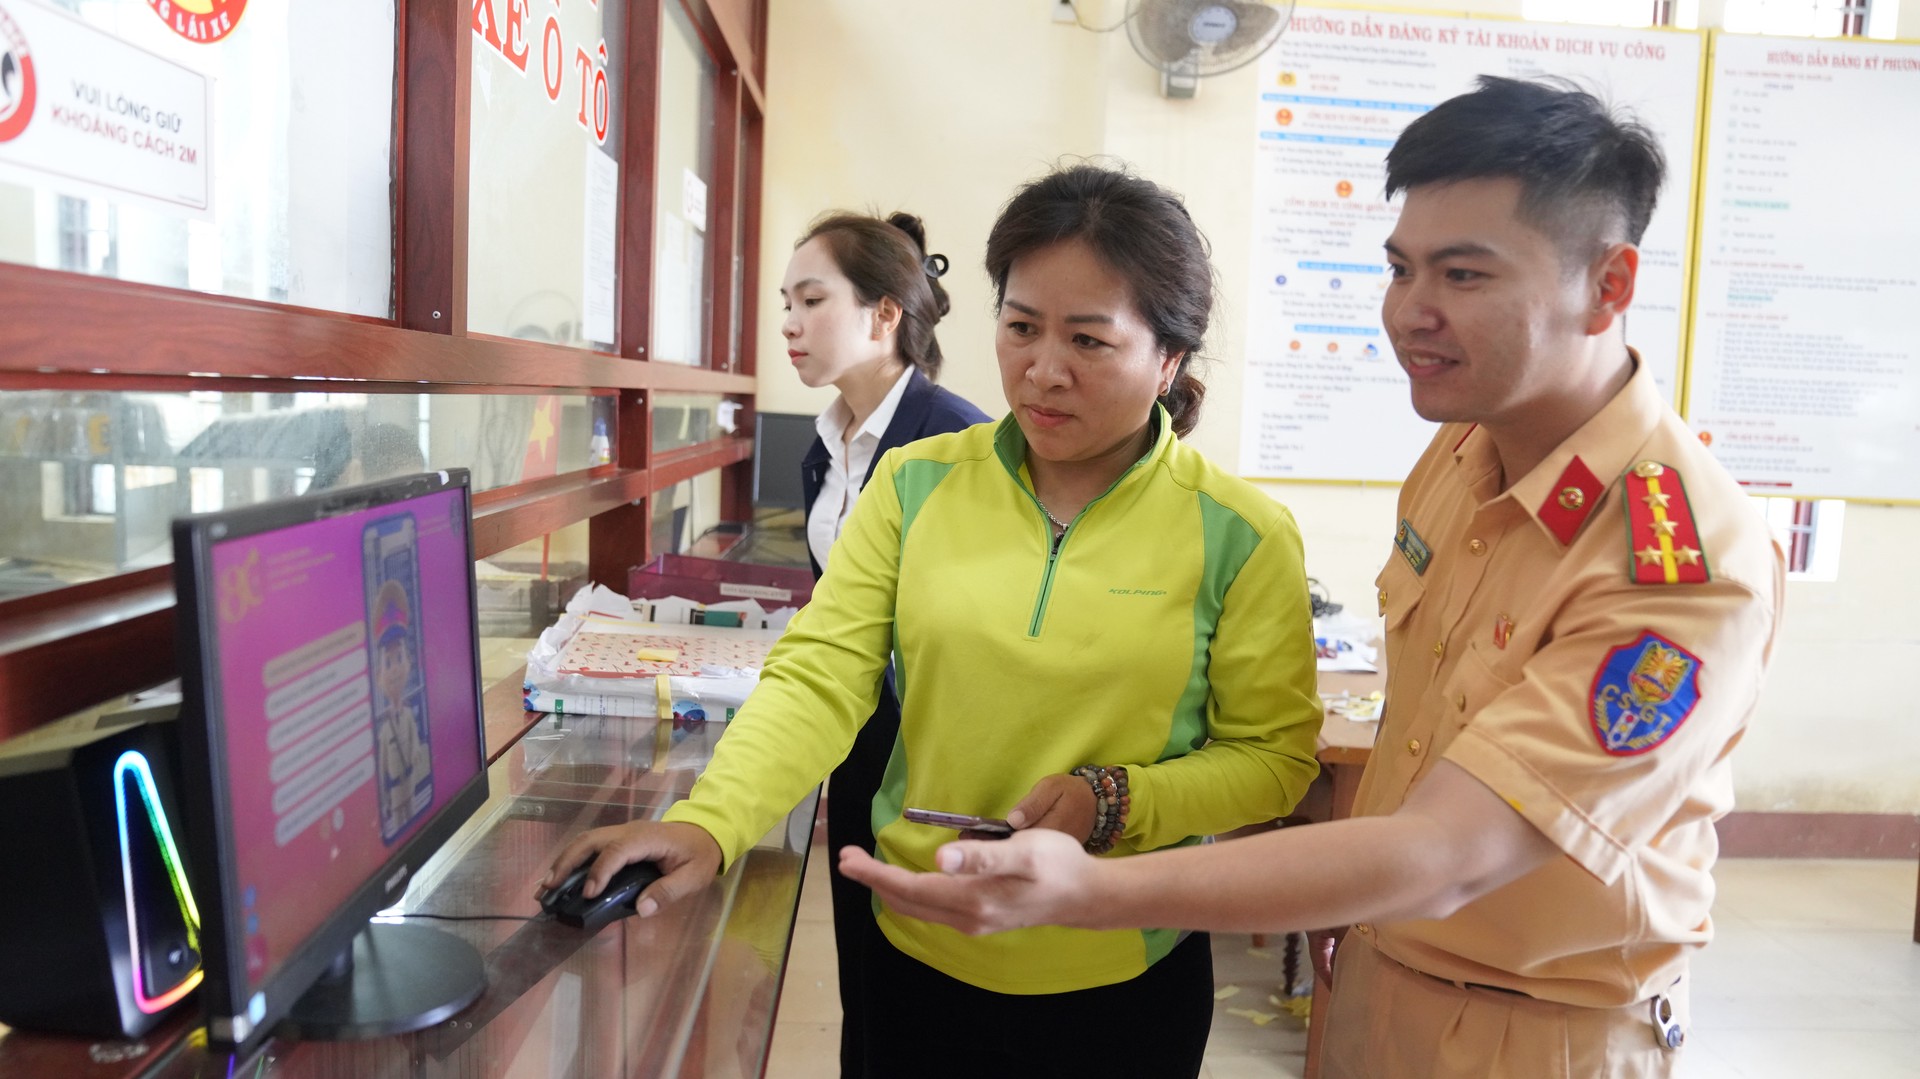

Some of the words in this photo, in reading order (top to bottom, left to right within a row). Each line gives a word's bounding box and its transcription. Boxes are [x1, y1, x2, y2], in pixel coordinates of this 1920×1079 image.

[176, 12, 207, 40] LÁI
[210, 11, 231, 38] XE
[1438, 25, 1460, 44] KÝ
[1466, 28, 1491, 47] TÀI
[1556, 37, 1593, 55] DỊCH
[1599, 39, 1619, 58] VỤ
[1624, 39, 1666, 60] CÔNG
[71, 79, 101, 106] VUI
[106, 91, 150, 123] LÒNG
[576, 43, 609, 141] TÔ
[51, 103, 127, 144] KHOẢNG
[133, 129, 175, 158] CÁCH
[179, 145, 197, 165] 2M
[1600, 684, 1672, 735] CSGT
